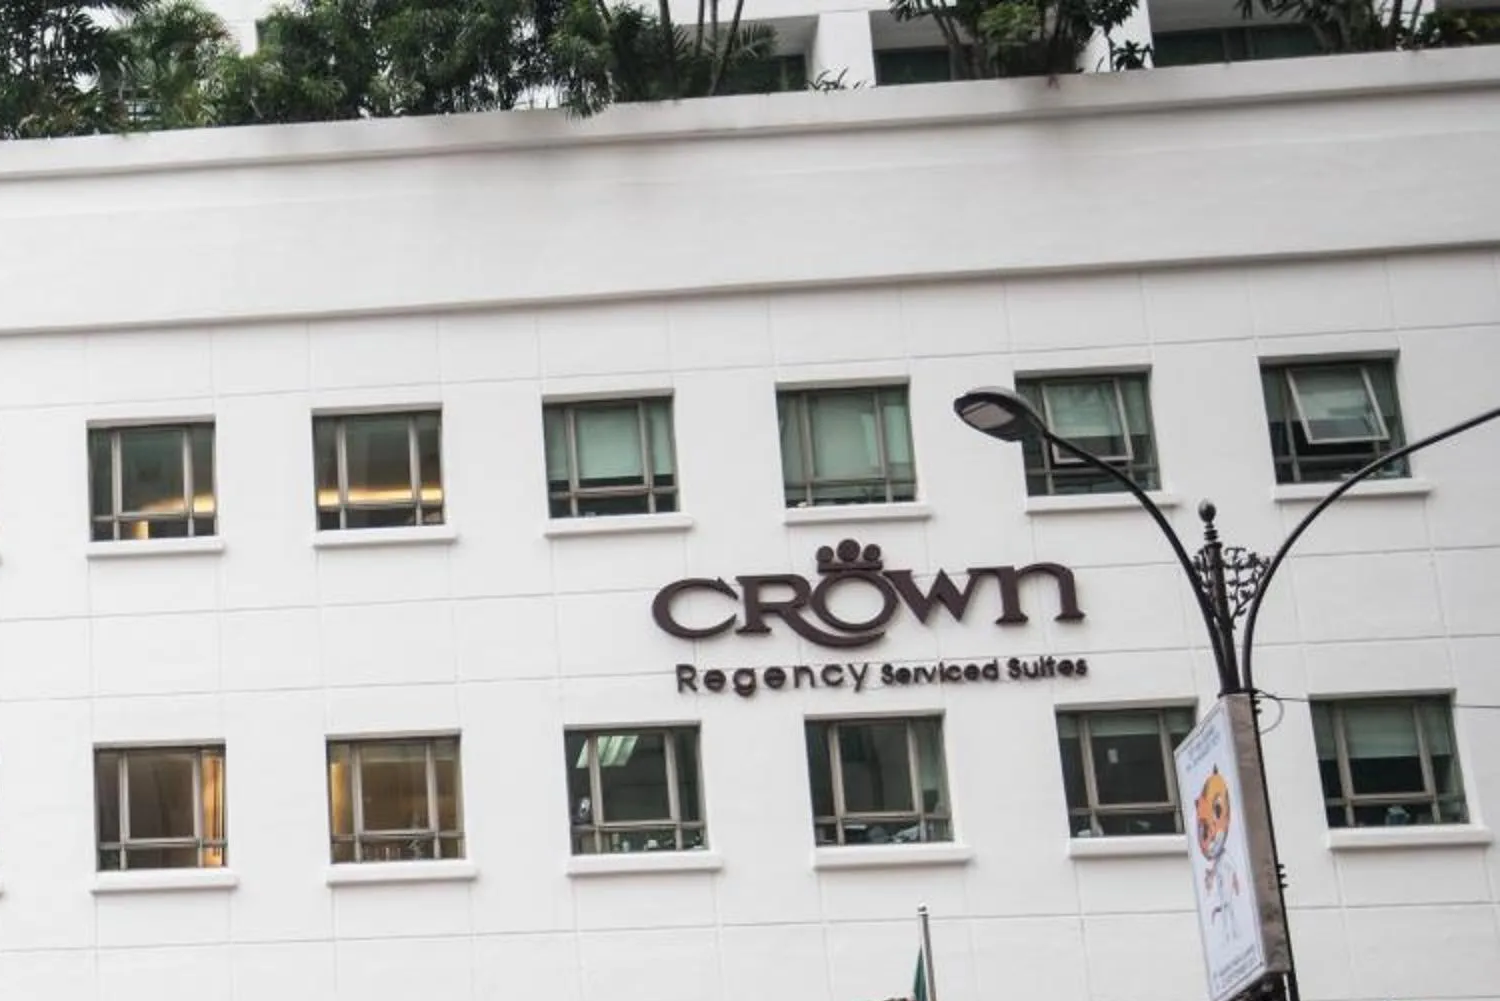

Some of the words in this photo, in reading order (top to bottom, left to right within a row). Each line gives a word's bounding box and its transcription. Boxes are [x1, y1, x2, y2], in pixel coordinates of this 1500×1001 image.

[675, 662, 869, 697] Regency
[881, 659, 1000, 686] Serviced
[1007, 655, 1088, 680] Suites
